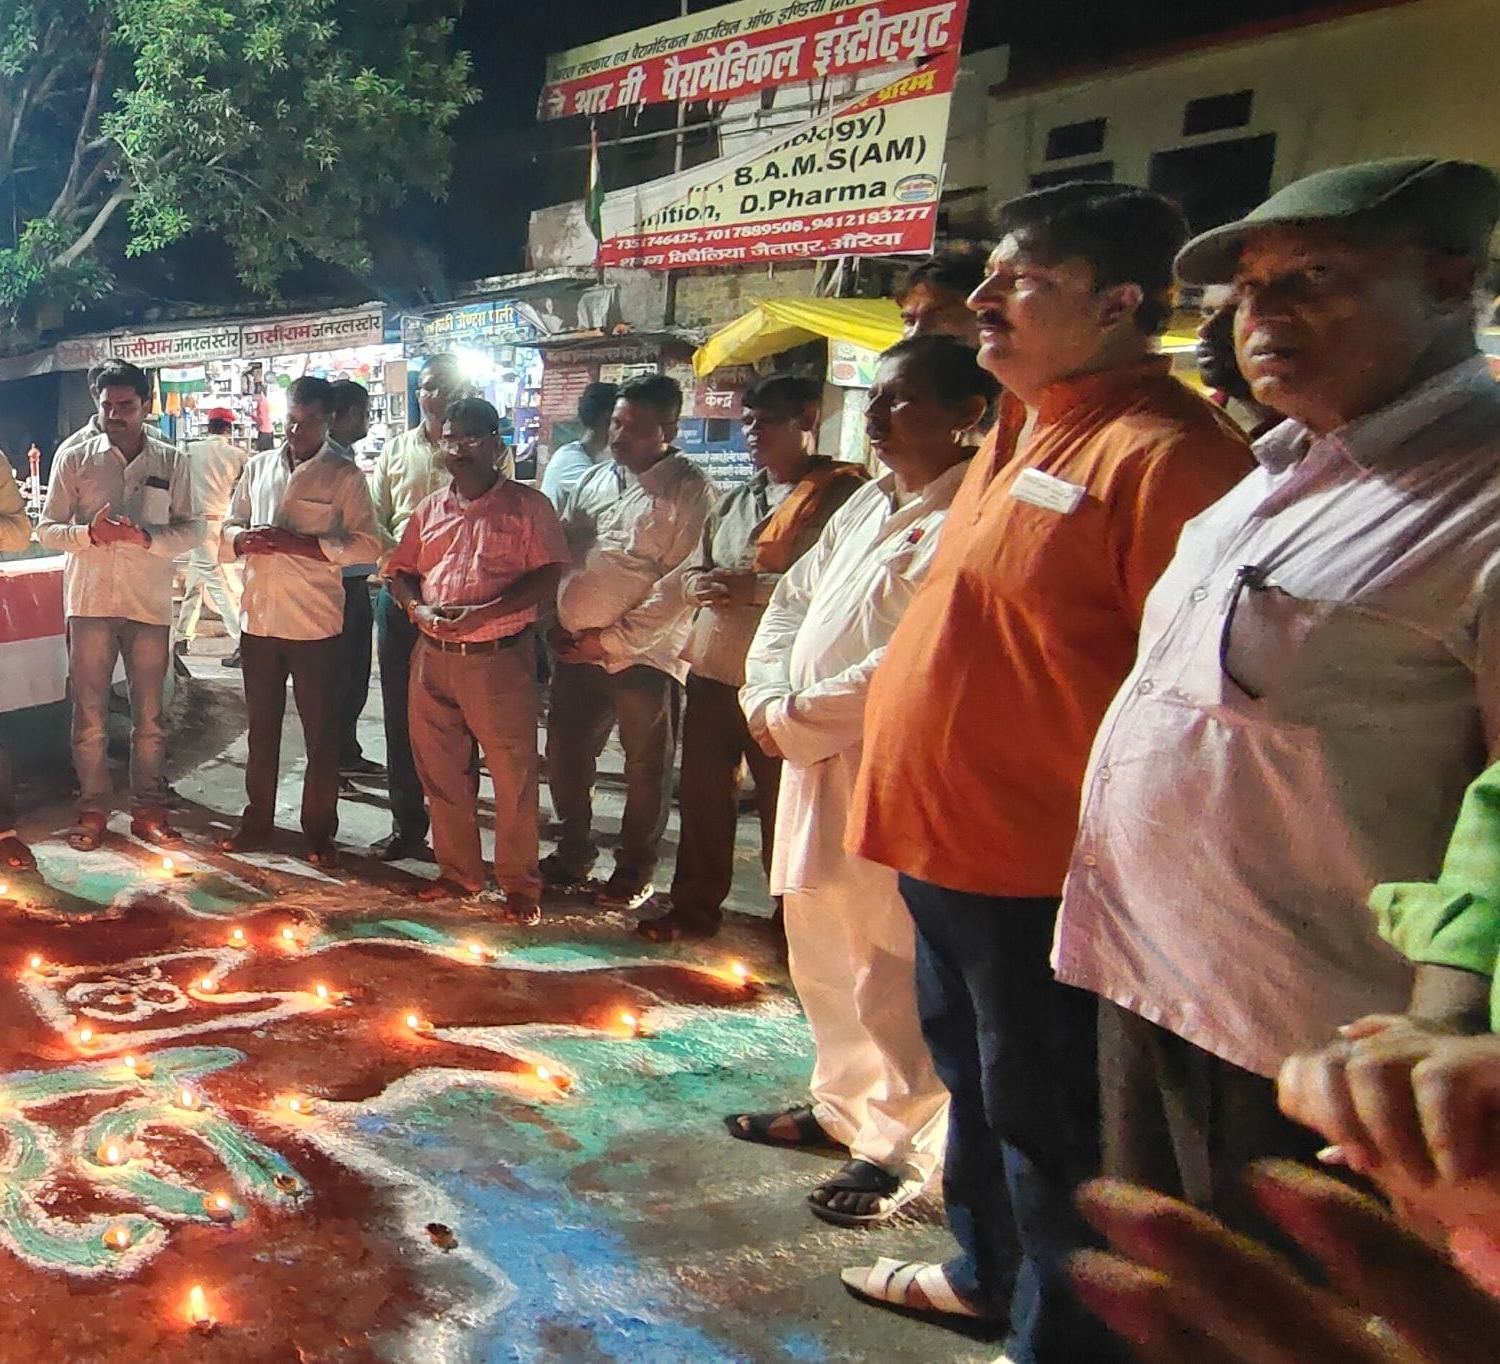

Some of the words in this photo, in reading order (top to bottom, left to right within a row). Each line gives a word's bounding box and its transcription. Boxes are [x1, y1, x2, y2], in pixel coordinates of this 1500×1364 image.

[576, 54, 613, 75] सरकार
[662, 36, 807, 103] पैरामेडिकल
[733, 134, 927, 187] B.A.M.S(AM)
[739, 180, 888, 215] D.Pharma
[113, 338, 172, 358] घासीराम
[243, 325, 310, 346] घासीराम
